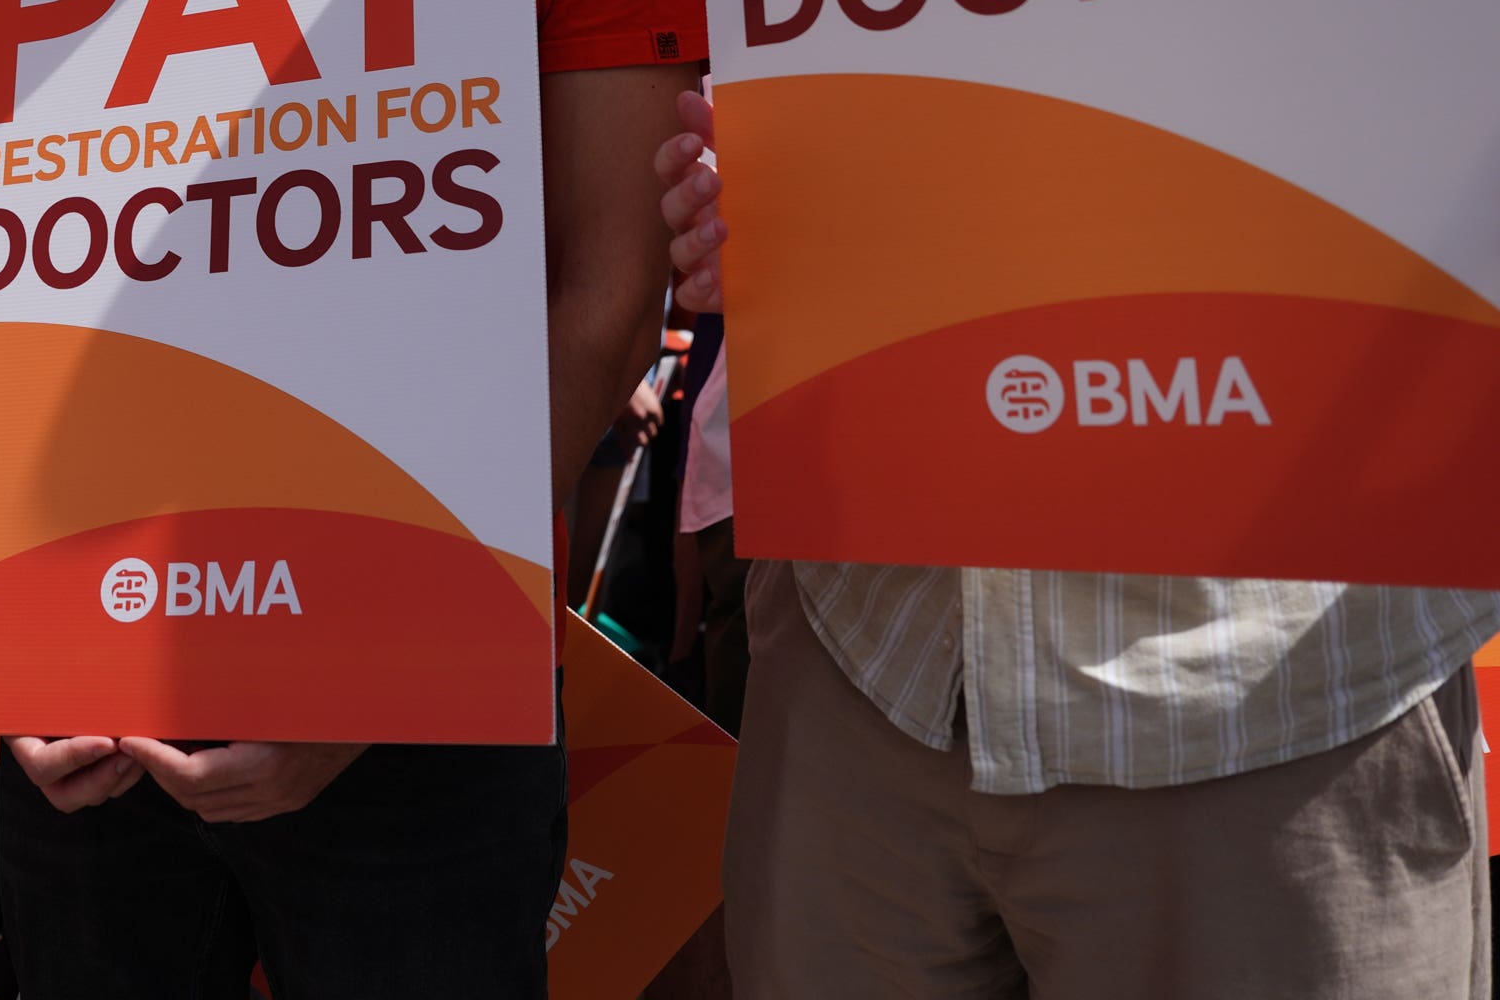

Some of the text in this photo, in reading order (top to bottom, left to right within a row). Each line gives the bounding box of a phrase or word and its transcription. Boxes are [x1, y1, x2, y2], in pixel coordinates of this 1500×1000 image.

[376, 77, 502, 139] FOR
[1072, 356, 1273, 427] BMA
[165, 559, 303, 617] BMA
